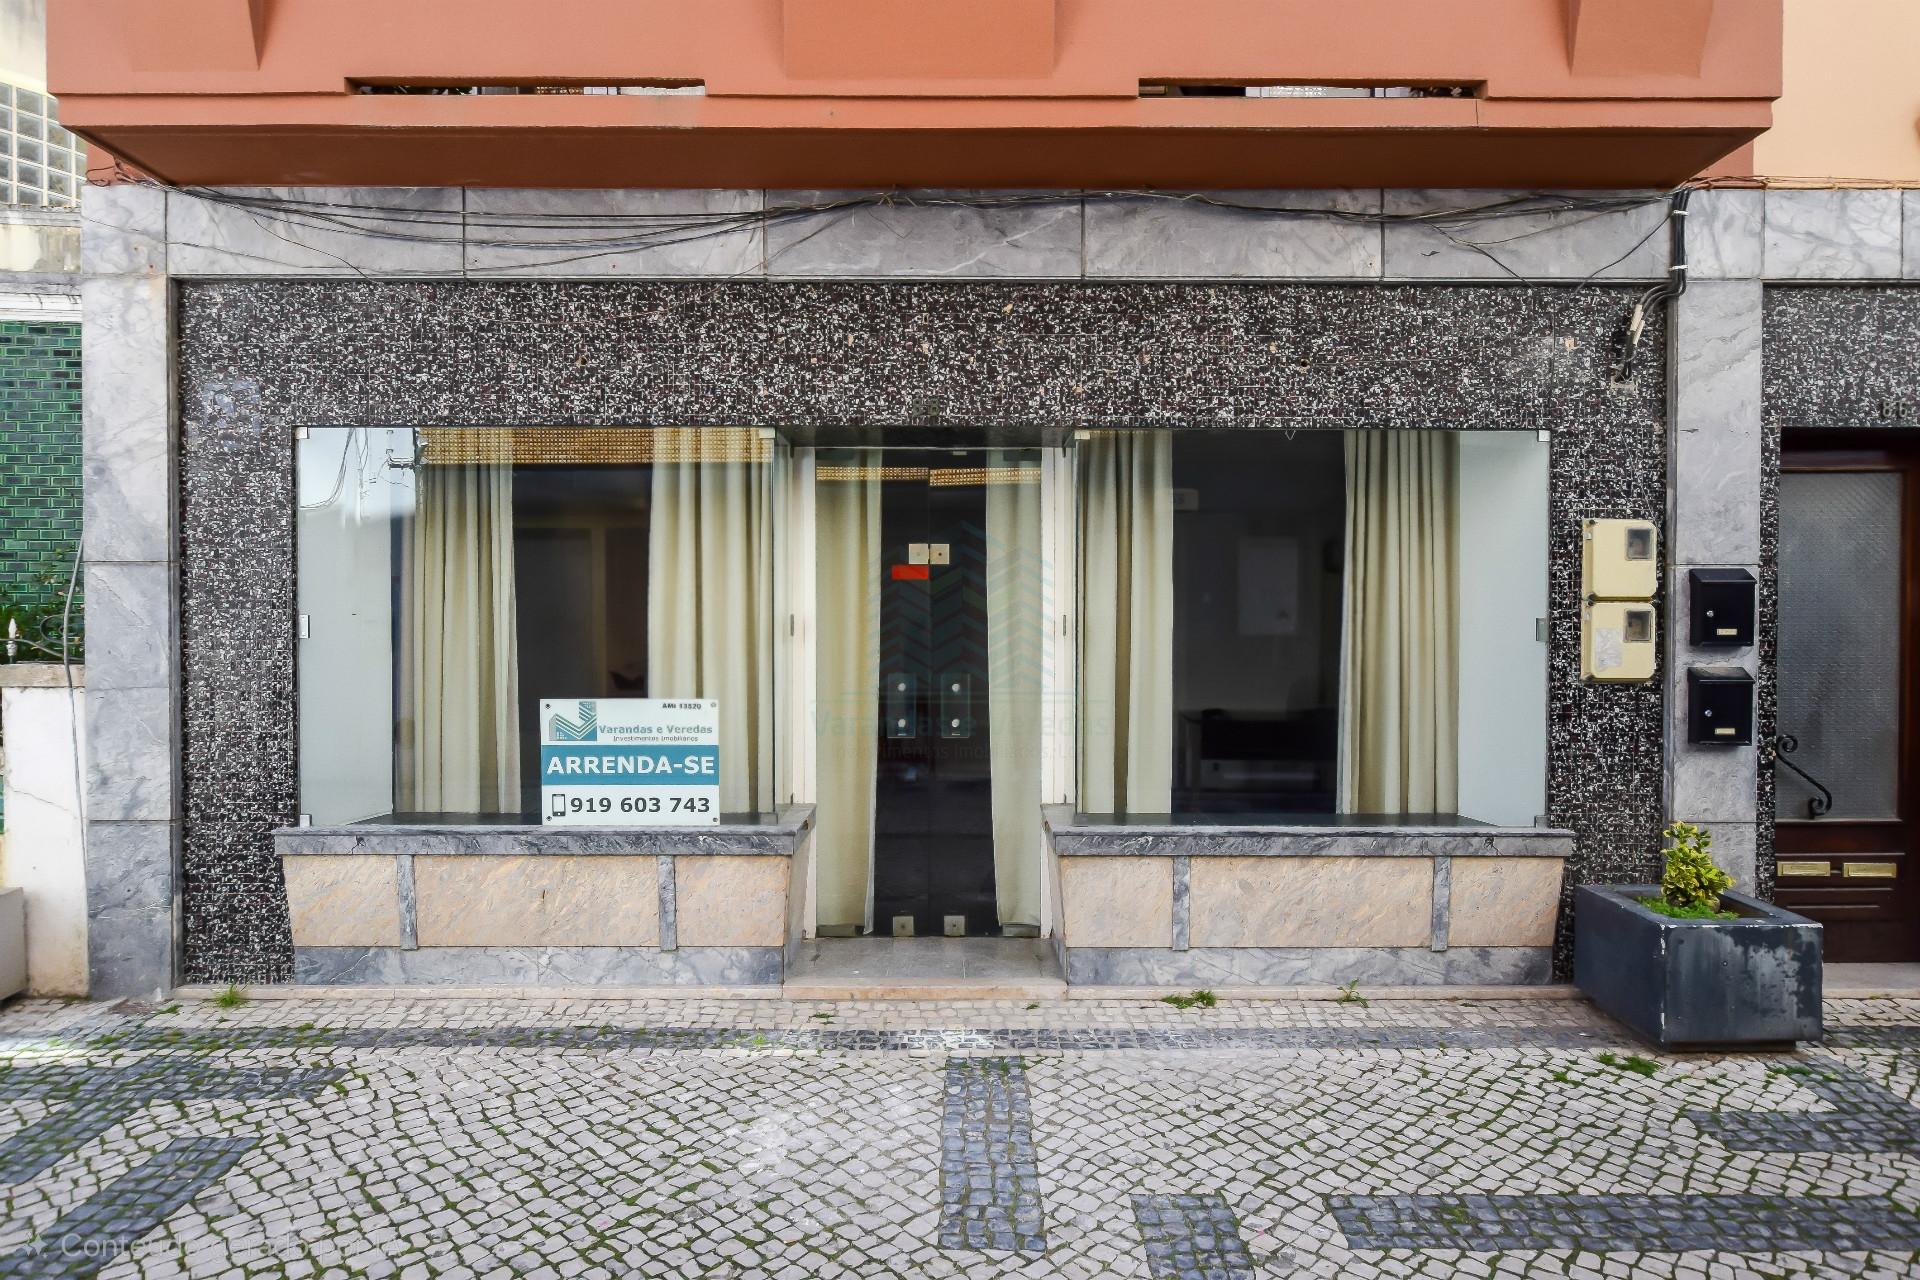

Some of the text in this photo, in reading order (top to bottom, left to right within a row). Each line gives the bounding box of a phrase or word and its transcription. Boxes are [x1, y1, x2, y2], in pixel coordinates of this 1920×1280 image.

[599, 725, 713, 734] Varandas e Veredas
[546, 756, 716, 775] ARRENDA-SE
[570, 797, 710, 813] 919 603 743
